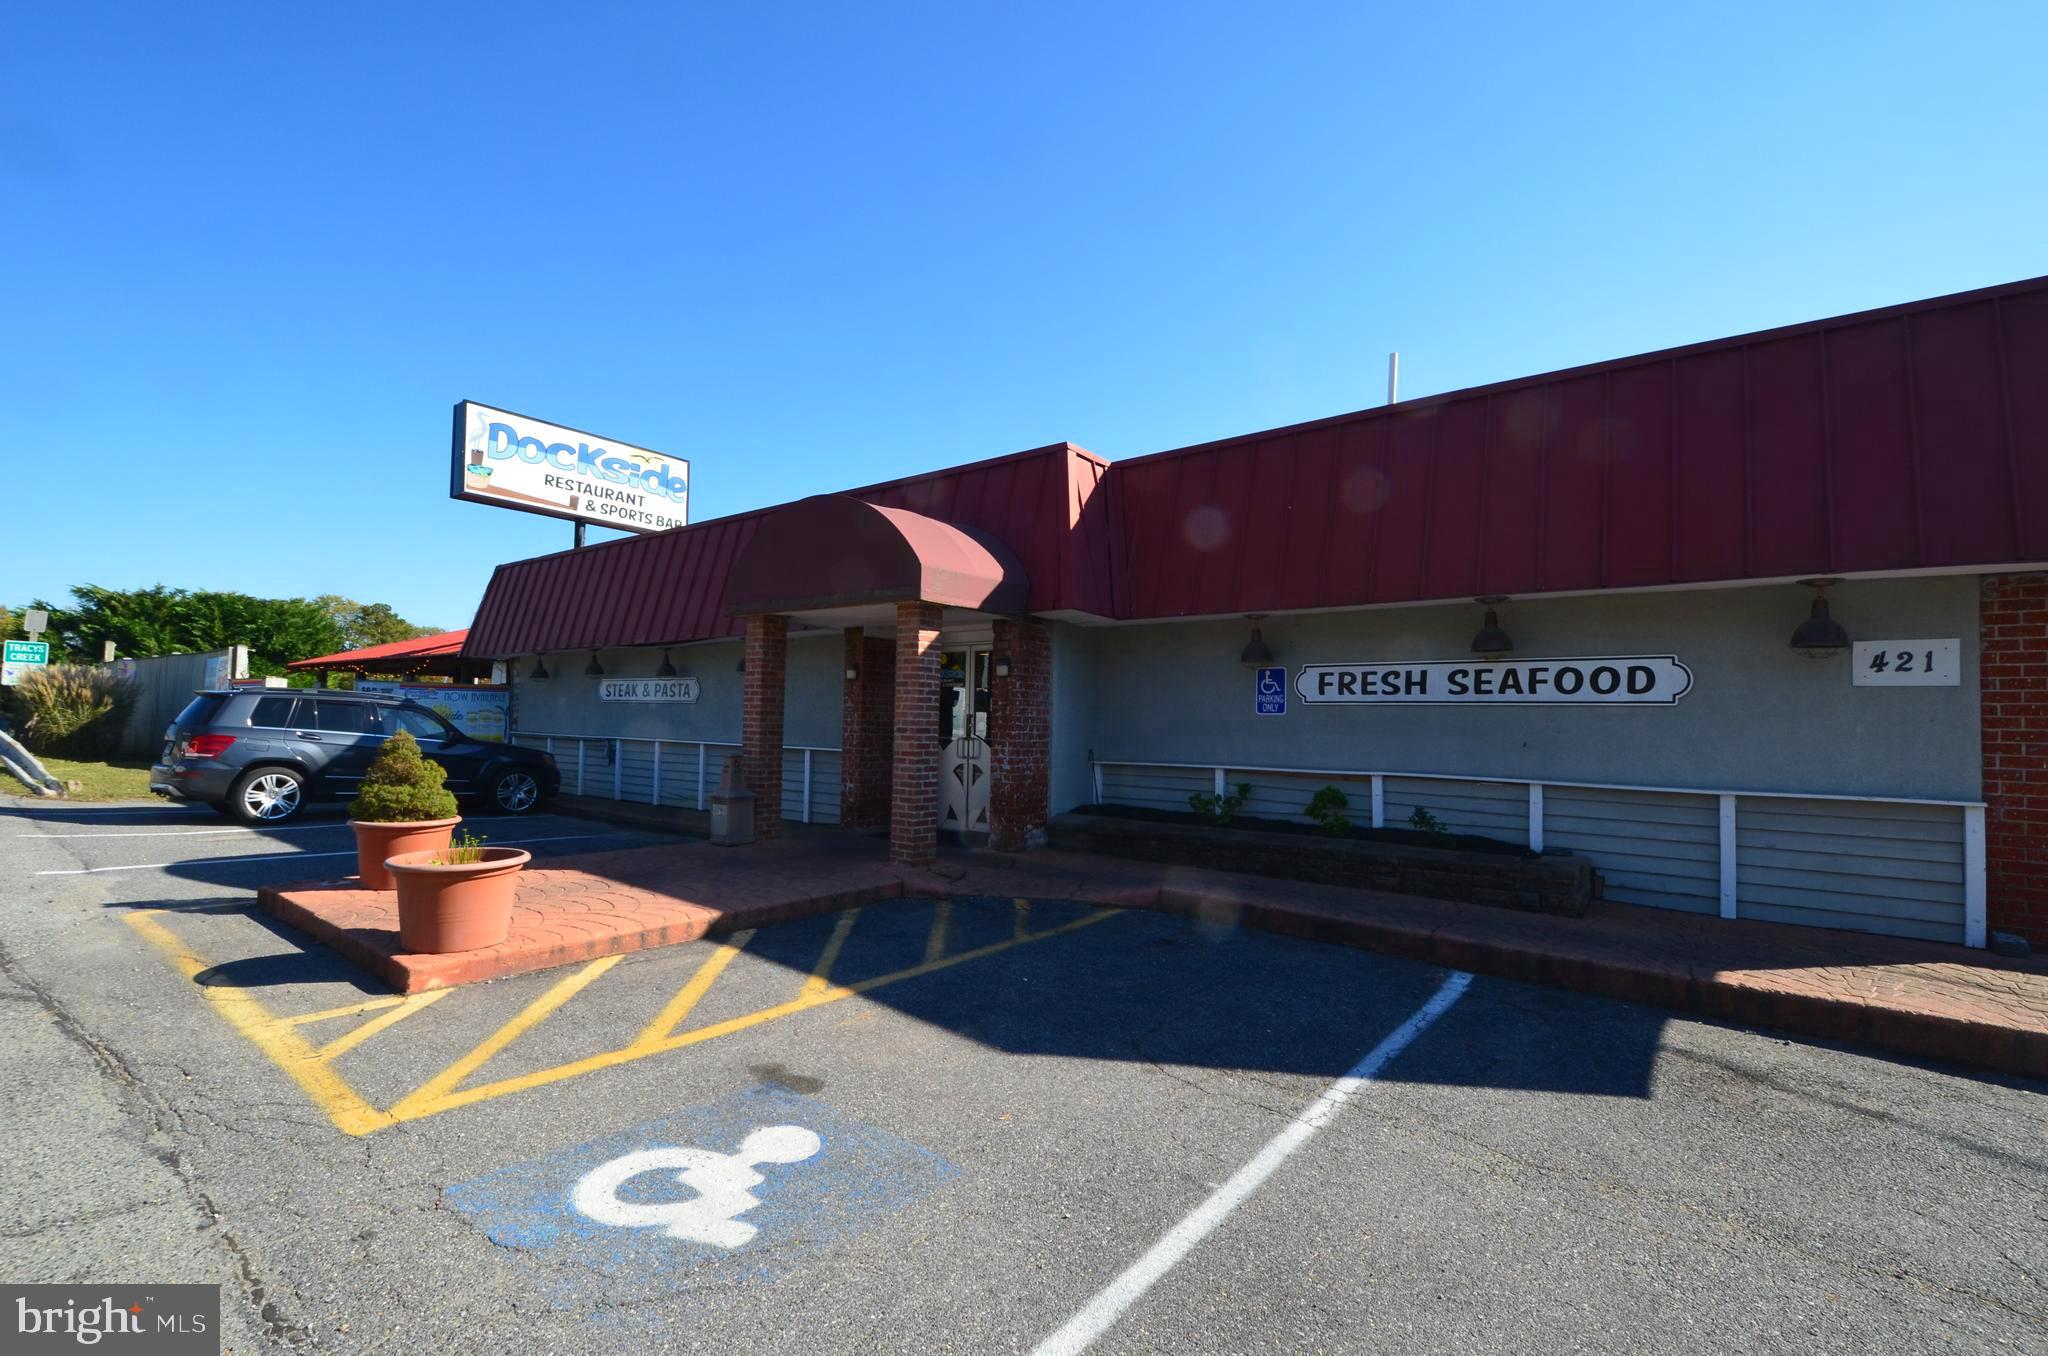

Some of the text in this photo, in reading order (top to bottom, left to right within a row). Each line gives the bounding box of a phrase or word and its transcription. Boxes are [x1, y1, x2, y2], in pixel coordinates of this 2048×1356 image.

[544, 474, 646, 507] RESTAURANT
[586, 500, 682, 528] & SPORTS BAR
[9, 644, 44, 653] TRACYS
[10, 653, 41, 661] CREEK
[1869, 650, 1934, 673] 421
[1318, 665, 1657, 695] FRESH SEAFOOD
[605, 683, 690, 698] STEAK & PASTA
[1258, 694, 1284, 703] PARKING
[1262, 703, 1279, 712] ONLY
